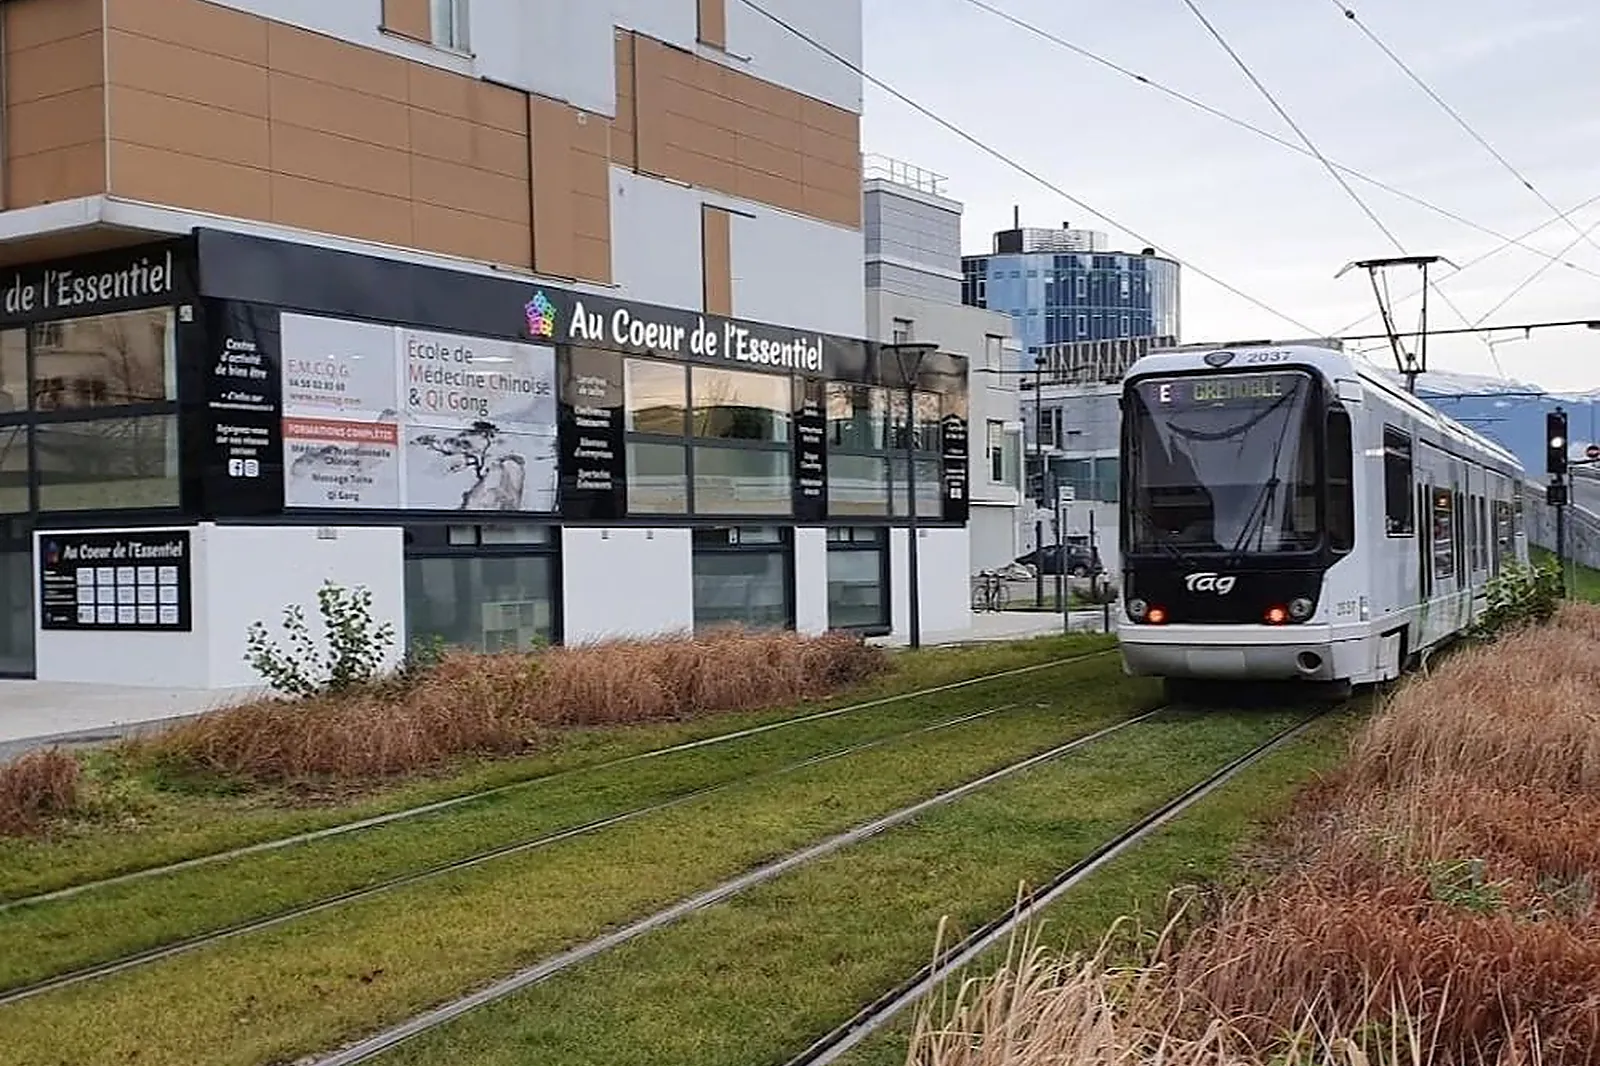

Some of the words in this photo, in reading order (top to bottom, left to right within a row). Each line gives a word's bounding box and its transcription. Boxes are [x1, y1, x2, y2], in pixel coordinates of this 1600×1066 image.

[6, 273, 33, 313] de
[44, 250, 173, 307] l'Essentiel
[569, 301, 603, 340] Au
[612, 308, 685, 351] Coeur
[690, 316, 718, 357] de
[724, 321, 823, 371] l'Essentiel
[454, 344, 474, 364] de
[1247, 351, 1294, 364] 2037
[409, 364, 485, 389] Médecine
[488, 373, 551, 396] Chinoise
[408, 388, 421, 407] &
[425, 389, 444, 411] Qi
[447, 391, 489, 417] Gong
[1158, 384, 1172, 403] E
[63, 545, 78, 560] Au
[79, 543, 111, 560] Coeur
[113, 541, 126, 559] de
[128, 540, 183, 558] l'Essentiel
[1185, 572, 1237, 596] Tag
